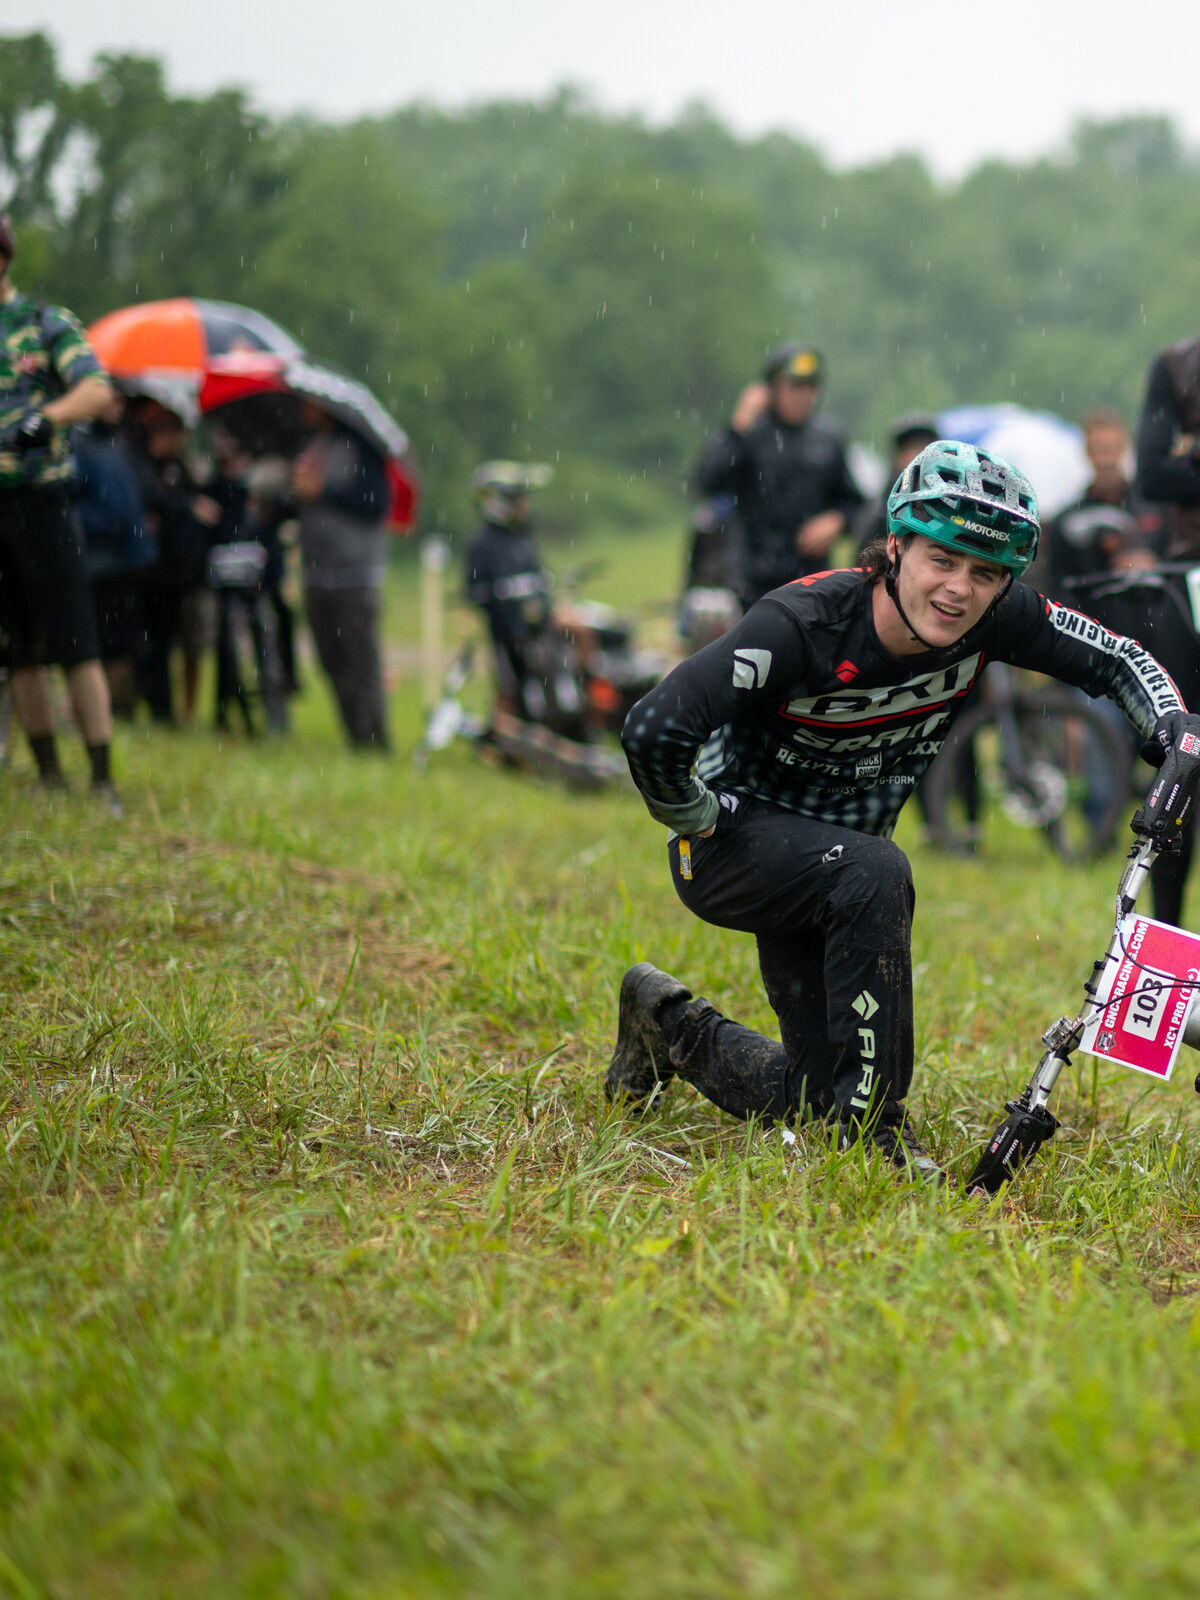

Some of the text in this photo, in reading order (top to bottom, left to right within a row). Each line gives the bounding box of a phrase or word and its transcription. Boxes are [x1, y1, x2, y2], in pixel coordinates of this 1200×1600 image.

[964, 520, 1011, 542] MOTOREX
[1182, 735, 1194, 752] ROCK
[775, 747, 843, 776] RE-LYTE
[879, 775, 915, 785] G-FORM
[1165, 784, 1179, 811] SRAM
[1104, 921, 1149, 1029] GNCCRACING.COM
[1132, 978, 1163, 1028] 103
[1163, 1024, 1179, 1049] XC1
[1171, 1001, 1186, 1026] PRO
[850, 1028, 875, 1110] ARI
[1001, 1138, 1020, 1165] SRAM
